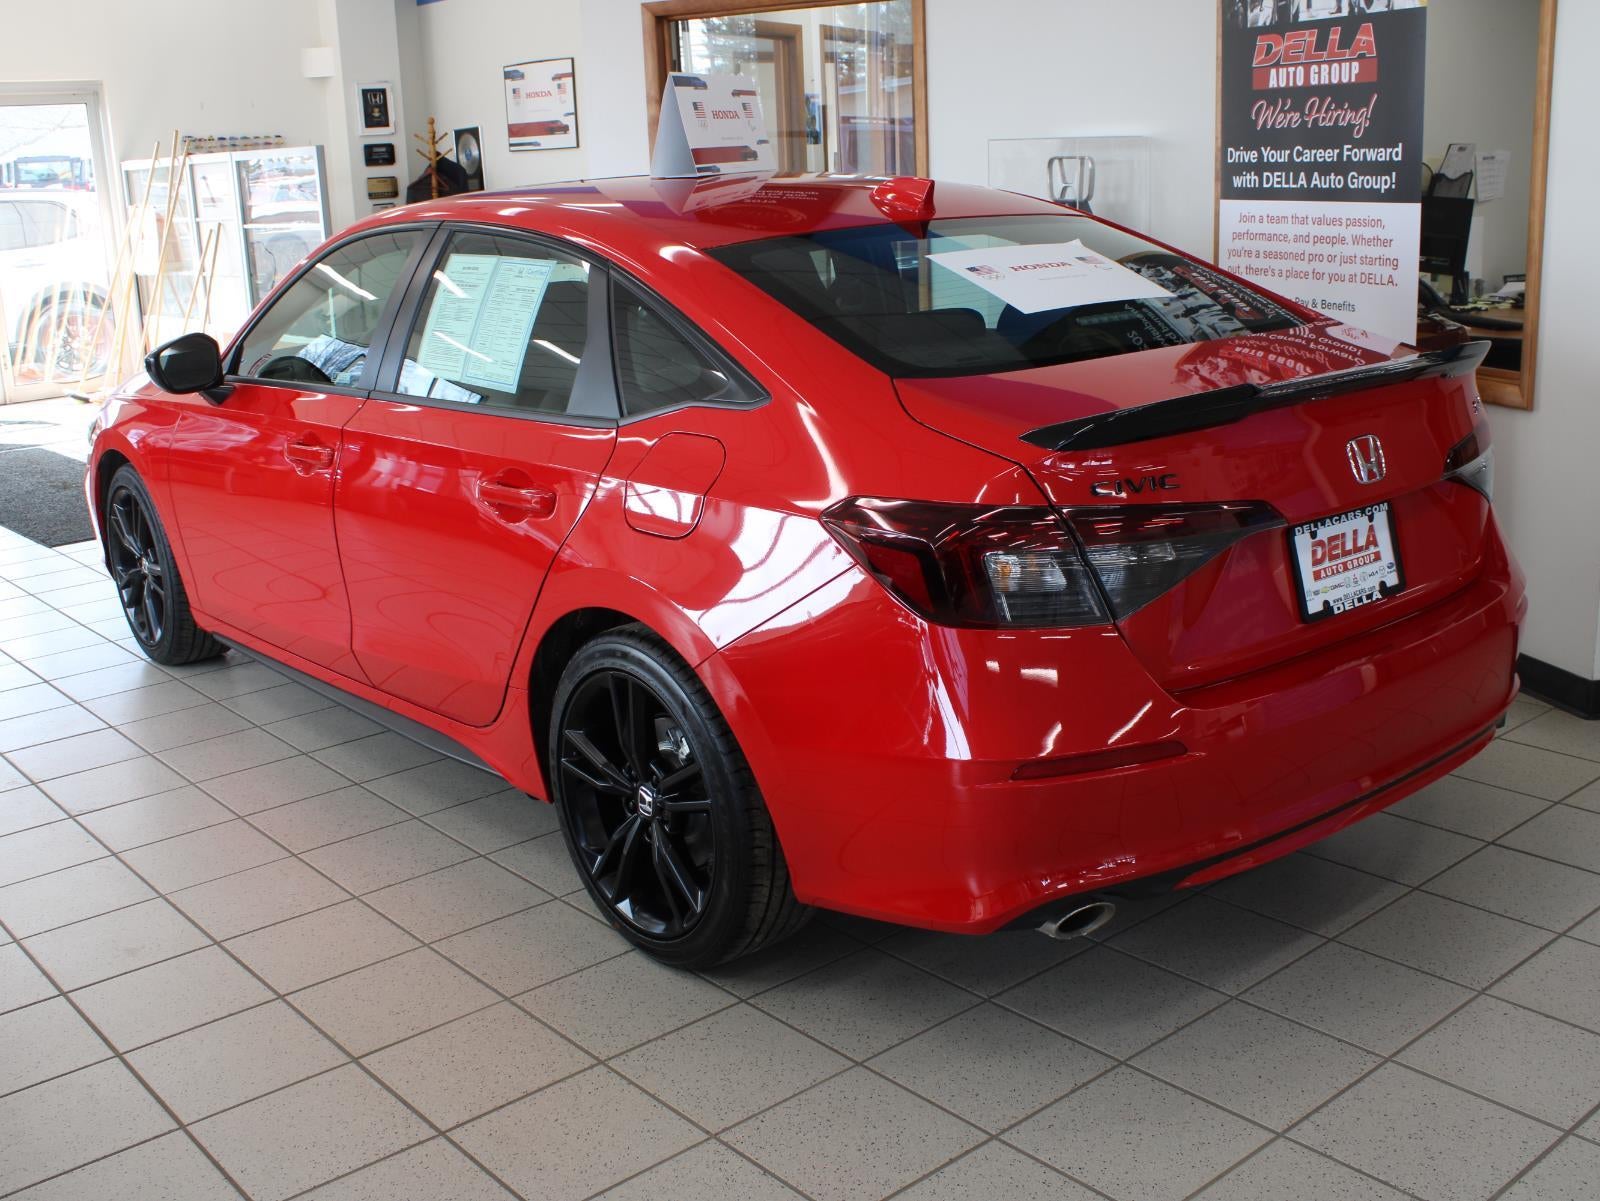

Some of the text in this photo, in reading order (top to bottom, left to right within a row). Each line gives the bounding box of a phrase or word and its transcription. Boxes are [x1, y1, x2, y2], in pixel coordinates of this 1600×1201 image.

[1252, 23, 1377, 67] DELLA
[1269, 62, 1360, 88] AUTO GROUP
[526, 90, 552, 99] HONDA
[711, 110, 740, 119] HONDA
[1252, 93, 1377, 138] We're Hiring!
[1227, 143, 1403, 163] Drive Your Career Forward
[1232, 171, 1397, 193] with DELLA Auto Group!
[1238, 212, 1385, 229] Join a team that values passion,
[1232, 229, 1394, 248] performance, and people. Whether
[1008, 262, 1073, 271] HONDA
[1227, 247, 1399, 270] you're a seasoned pro or just starting
[1245, 264, 1275, 277] there's
[1277, 268, 1283, 278] a
[1285, 267, 1310, 280] place
[1311, 268, 1325, 281] for
[1328, 272, 1346, 284] you
[1348, 272, 1357, 283] at
[1360, 272, 1398, 287] DELLA.
[1311, 298, 1318, 309] &
[1321, 299, 1356, 312] Benefits
[1090, 474, 1180, 497] CIVIC
[1295, 502, 1389, 536] DELLACARS.COM
[1311, 524, 1379, 568] DELLA
[1320, 553, 1375, 579] AUTO GROUP
[1333, 591, 1383, 614] DELLA
